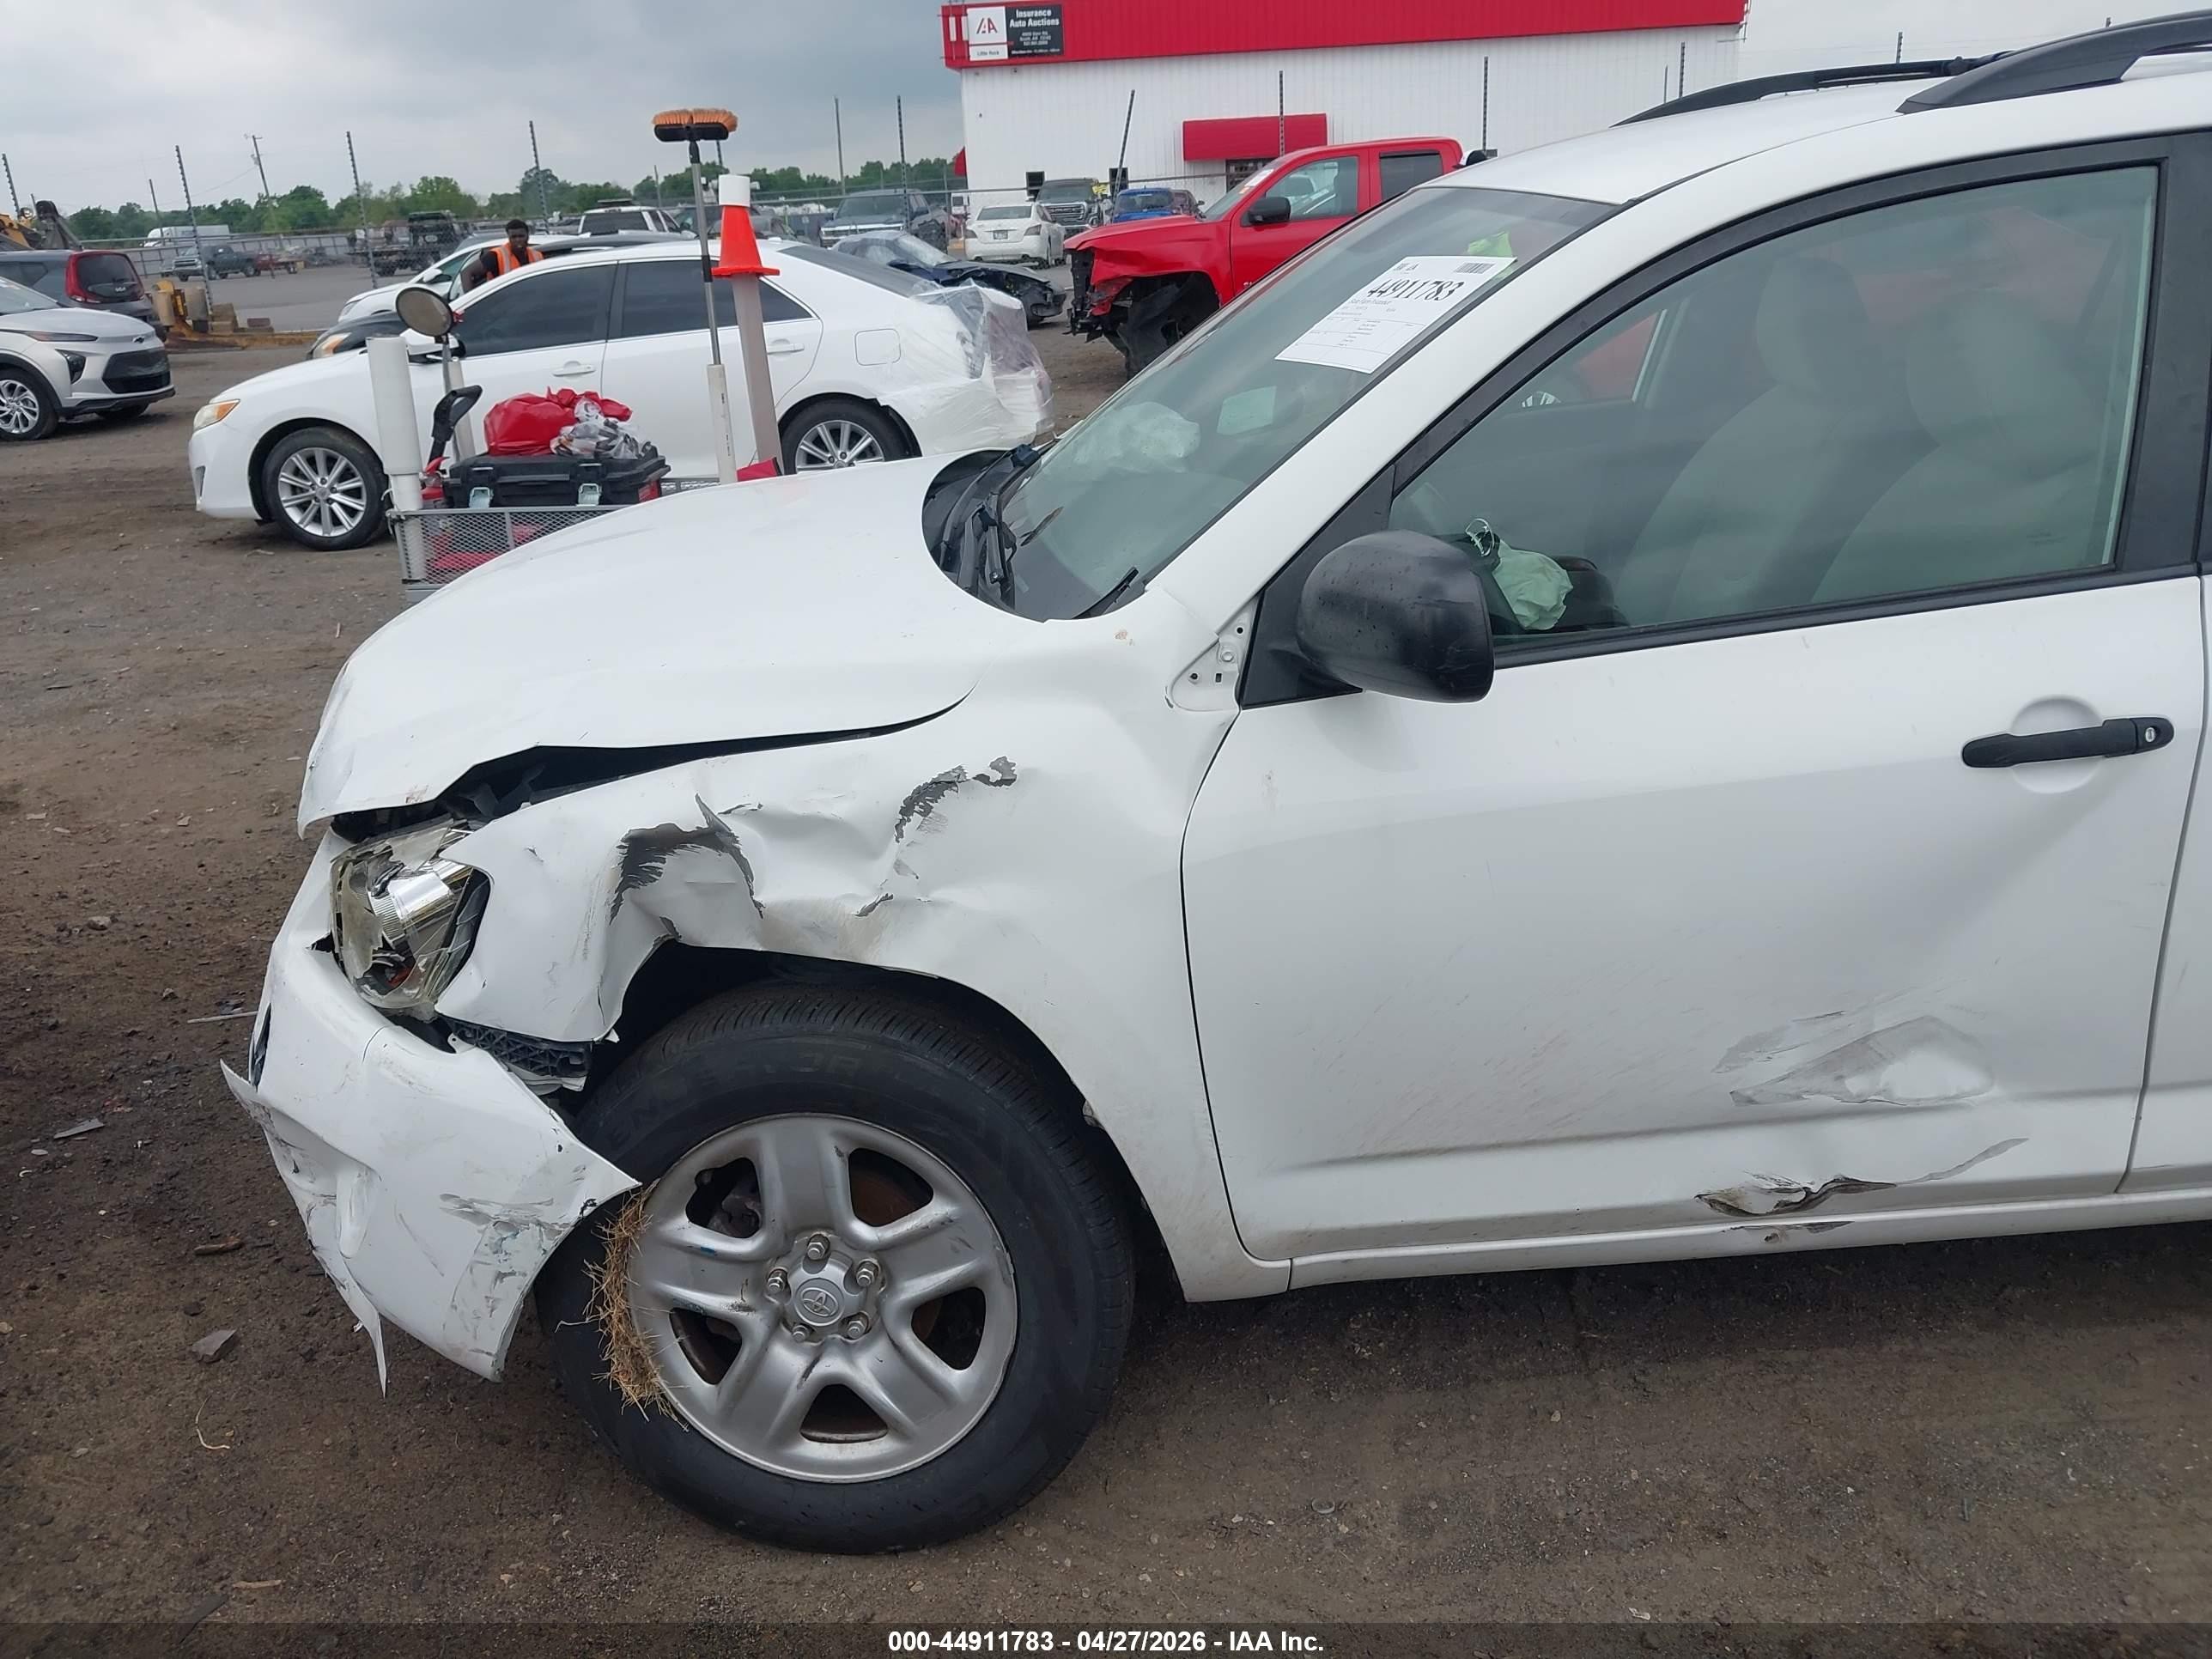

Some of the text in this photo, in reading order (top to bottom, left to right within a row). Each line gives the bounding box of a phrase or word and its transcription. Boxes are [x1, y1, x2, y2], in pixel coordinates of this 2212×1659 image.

[1016, 9, 1052, 18] Insurance
[1028, 17, 1060, 27] Auctions
[1367, 279, 1465, 301] 44911783
